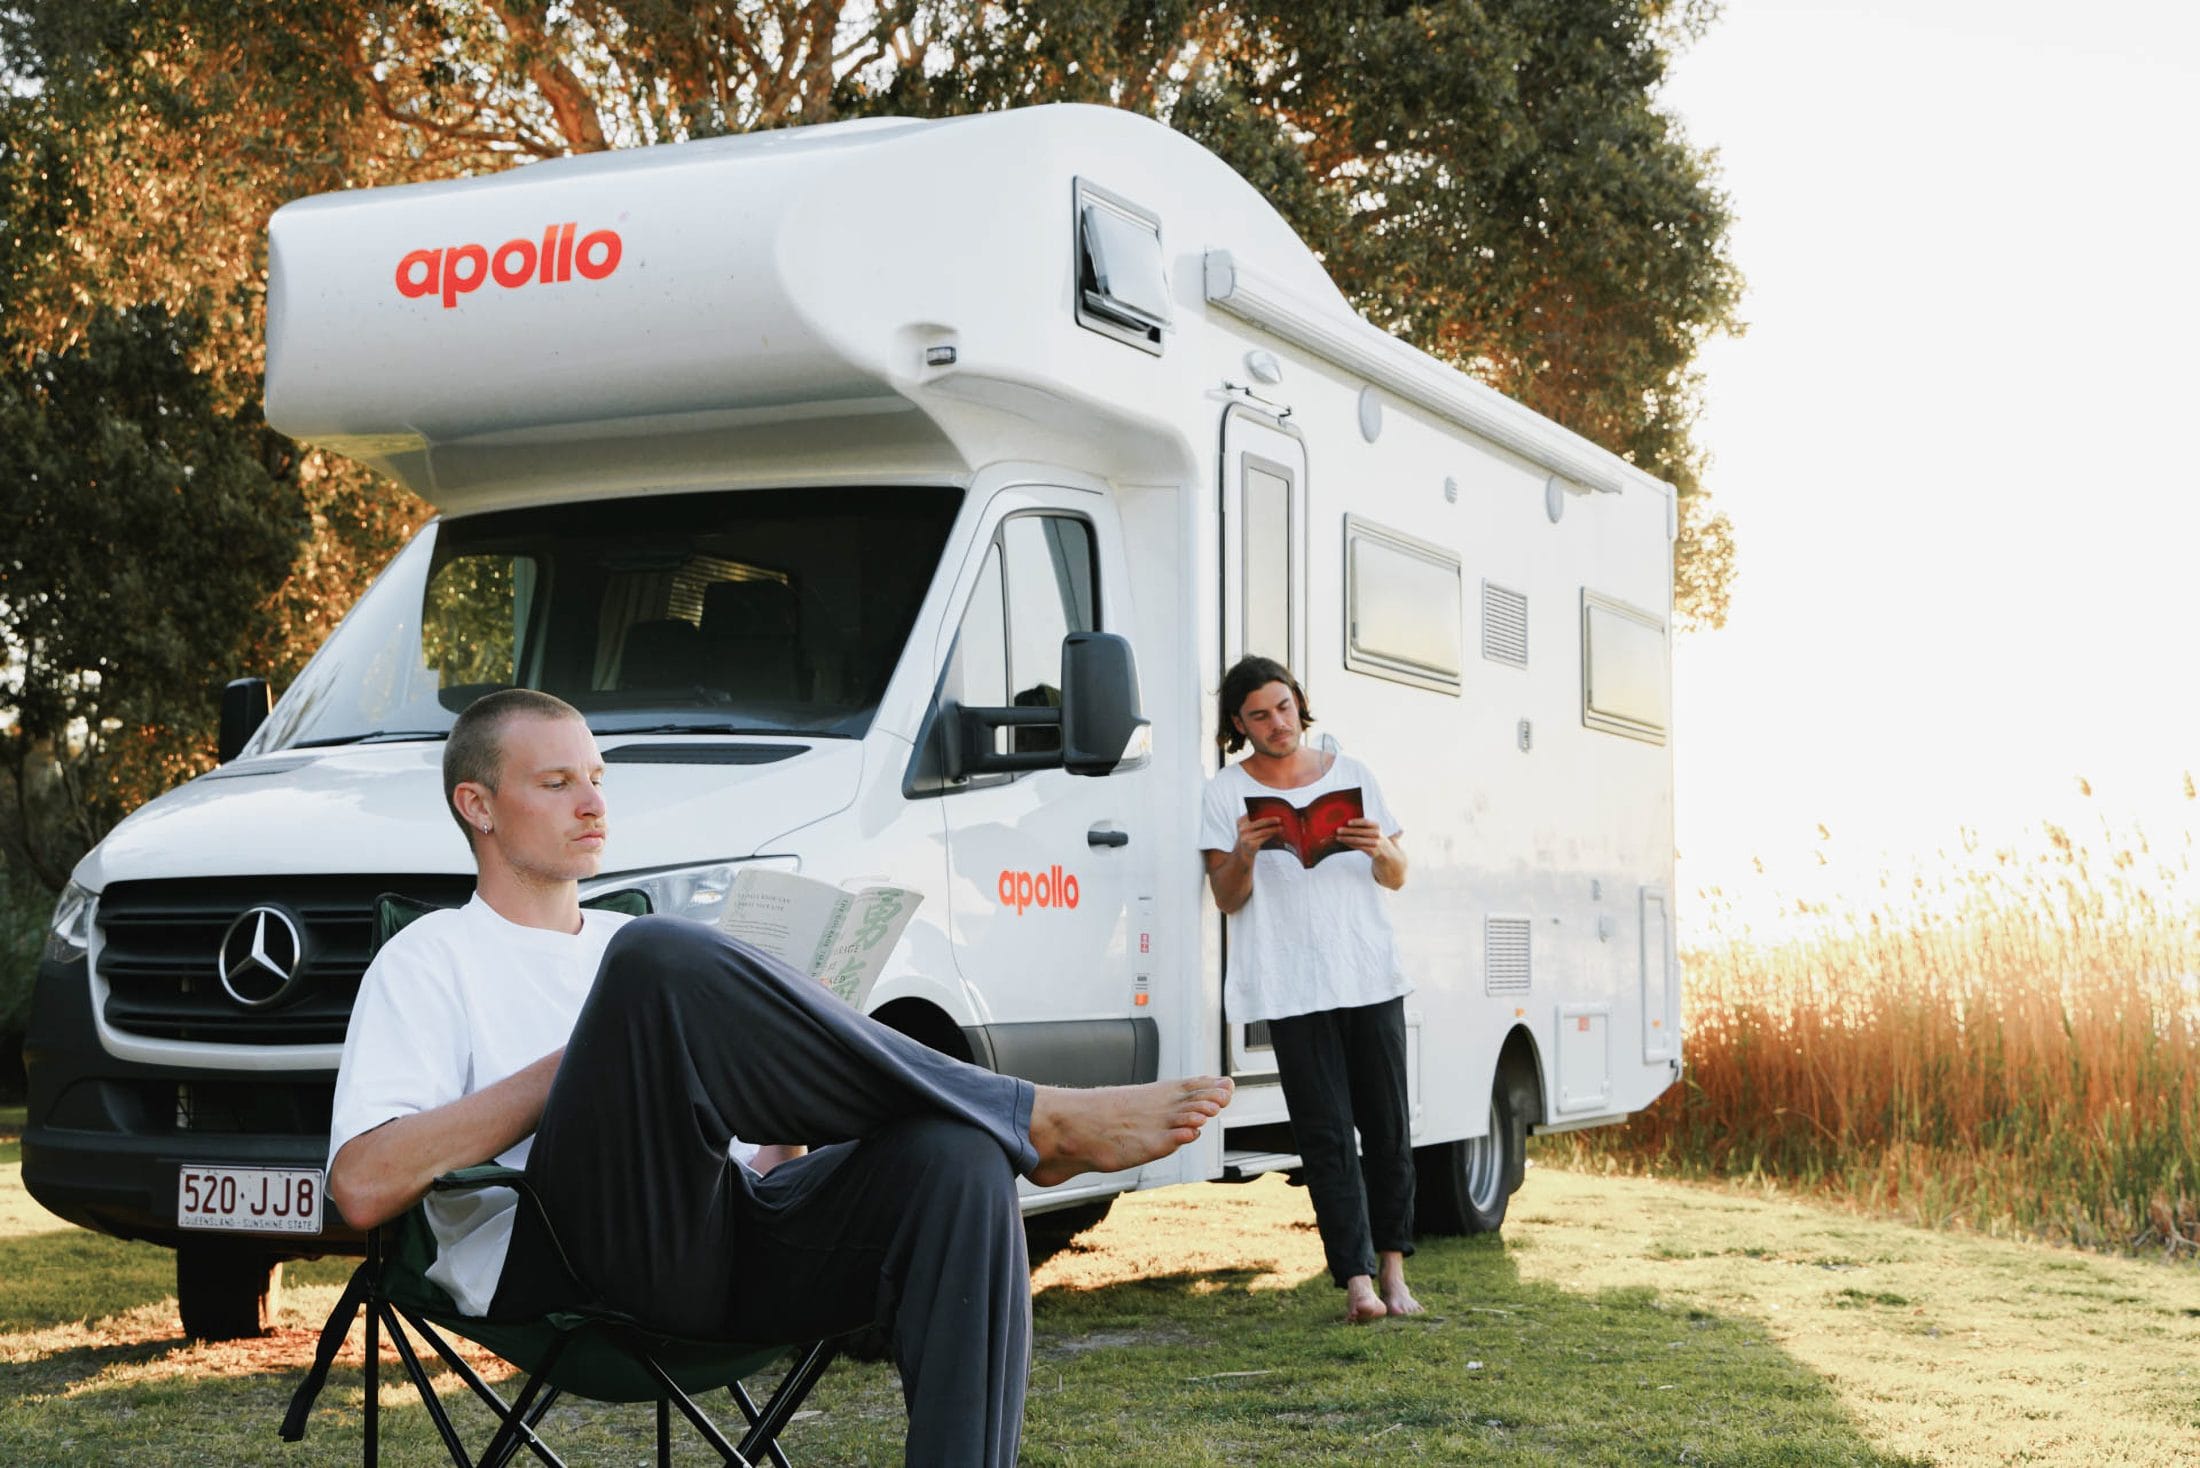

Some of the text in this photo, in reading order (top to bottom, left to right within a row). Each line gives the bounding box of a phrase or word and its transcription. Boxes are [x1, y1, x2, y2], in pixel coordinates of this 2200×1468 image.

[395, 222, 622, 309] apollo
[999, 864, 1080, 916] apollo
[287, 1220, 312, 1230] STATE
